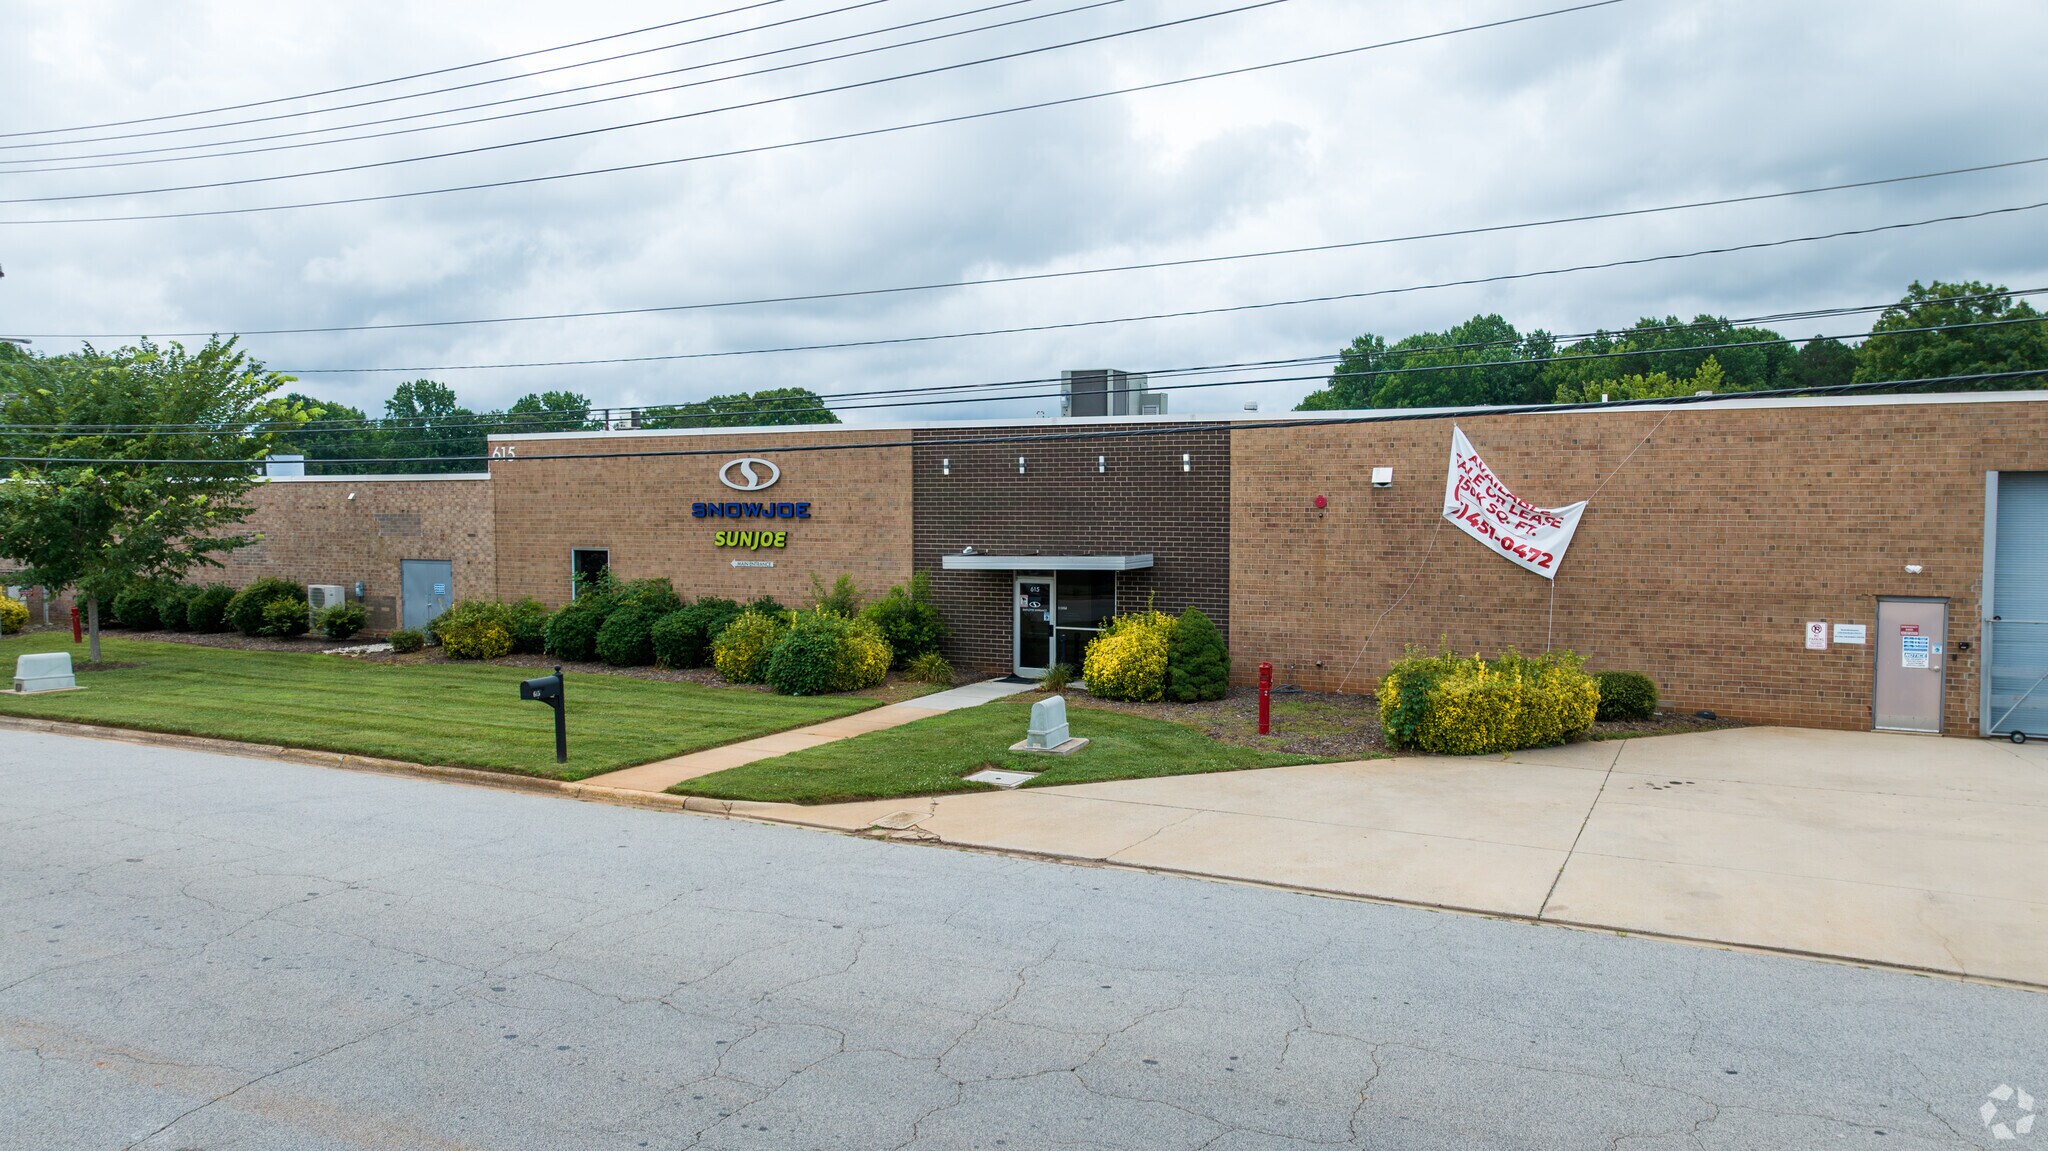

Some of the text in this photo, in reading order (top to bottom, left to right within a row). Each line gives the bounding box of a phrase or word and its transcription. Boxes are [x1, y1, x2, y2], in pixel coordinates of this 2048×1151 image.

[492, 446, 515, 461] 615
[692, 502, 811, 518] SNOWJOE
[714, 531, 787, 551] SUNJOE
